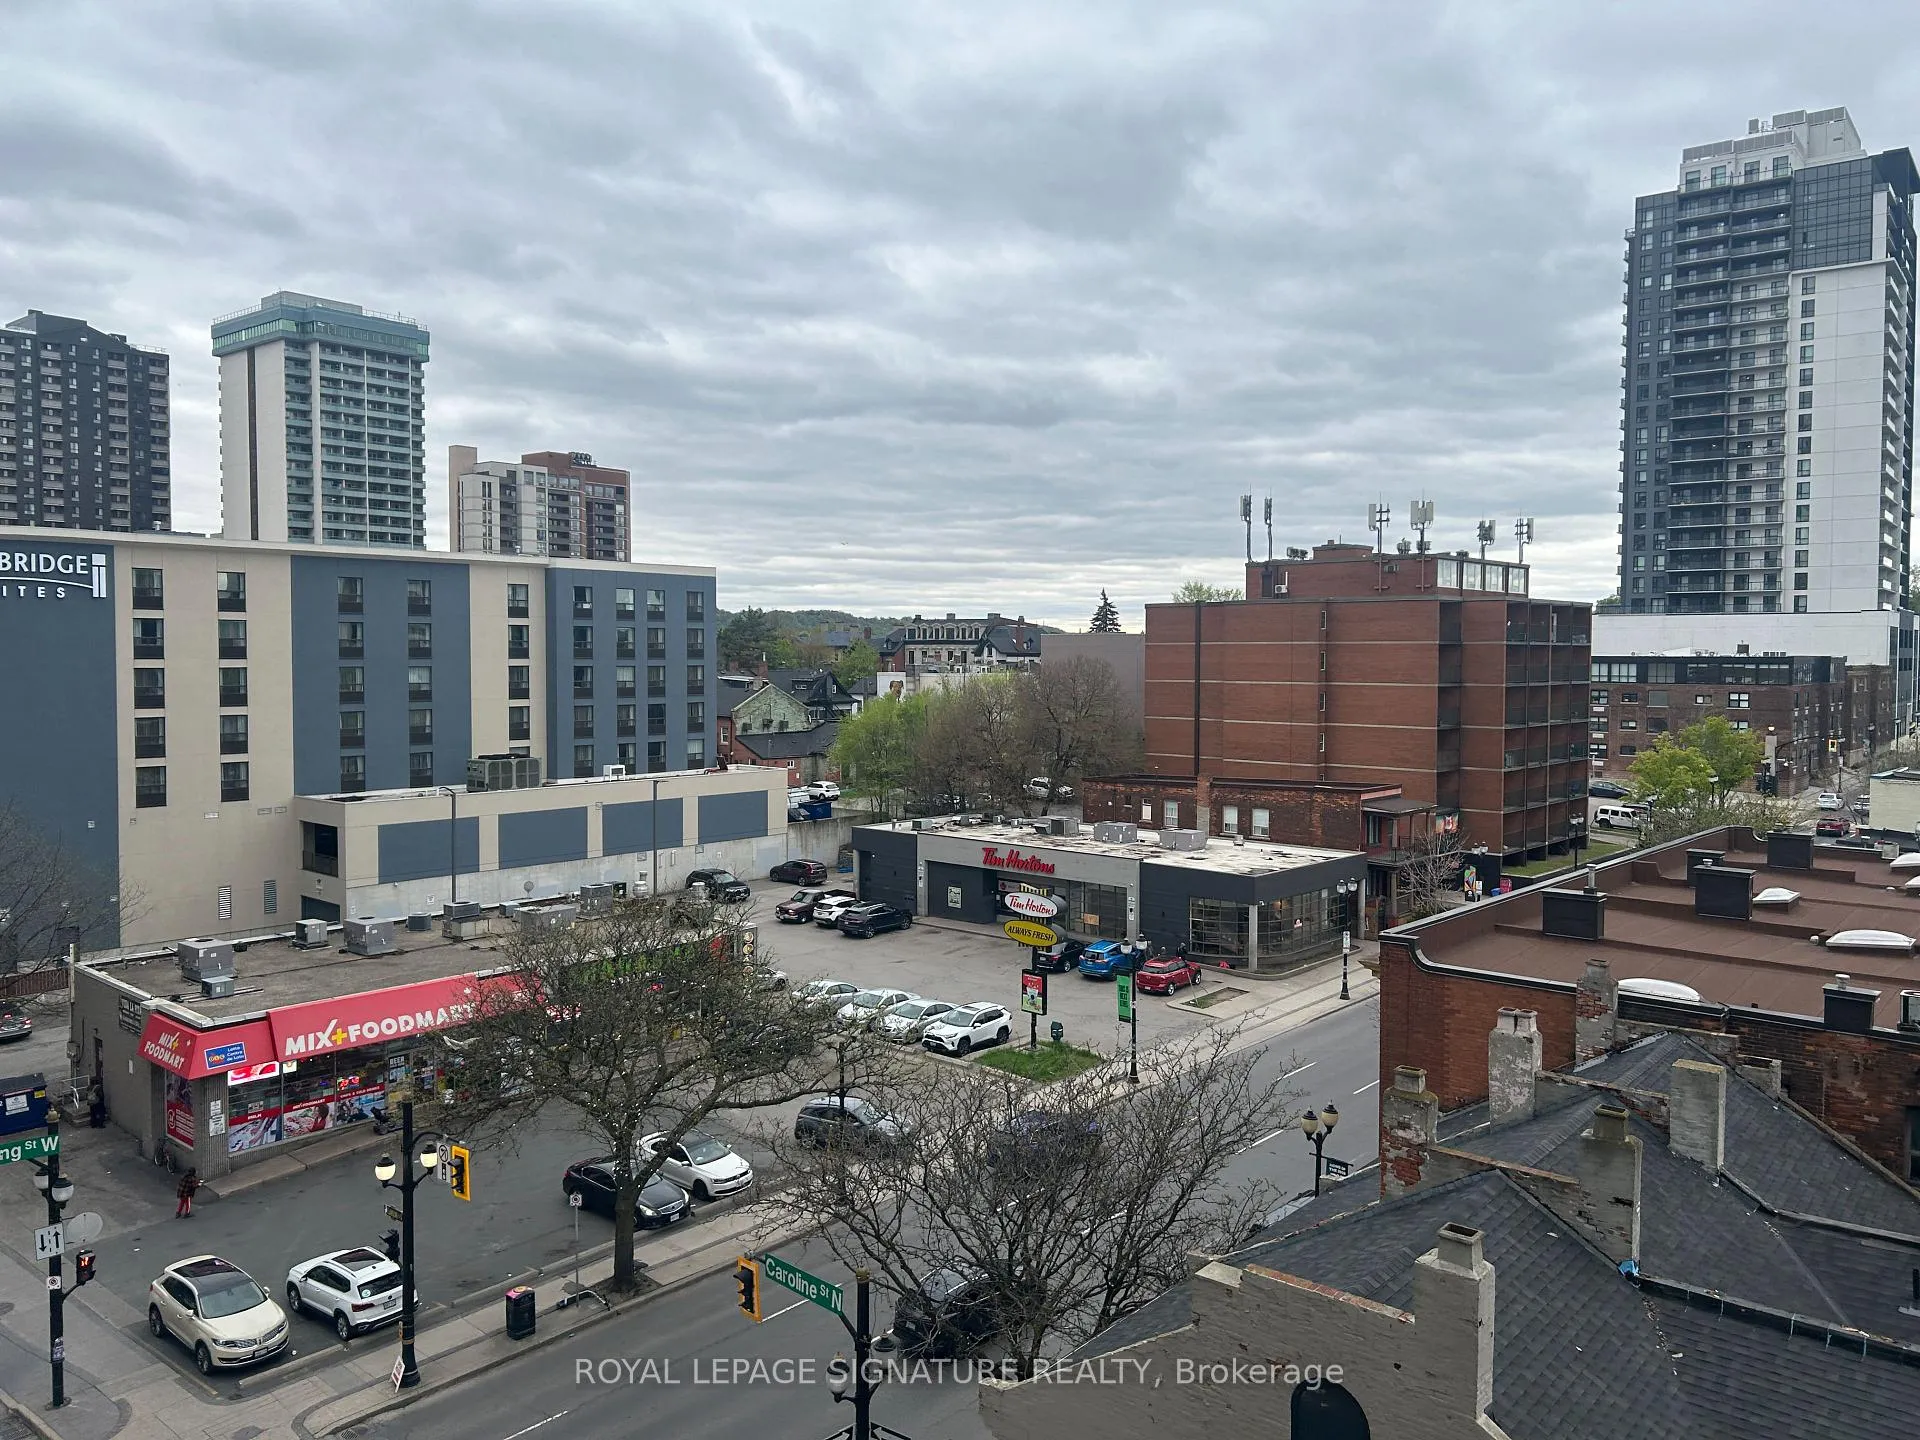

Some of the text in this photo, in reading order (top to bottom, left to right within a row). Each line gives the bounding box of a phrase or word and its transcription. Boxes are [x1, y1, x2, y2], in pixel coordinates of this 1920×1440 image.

[982, 847, 1055, 874] Tim Hortons
[1009, 894, 1054, 916] Tim Hortons
[1007, 925, 1054, 943] ALWAYS FRESH
[144, 1041, 185, 1069] FOODMART
[24, 1140, 37, 1150] St
[41, 1135, 59, 1152] W
[765, 1257, 843, 1311] Caroline St N
